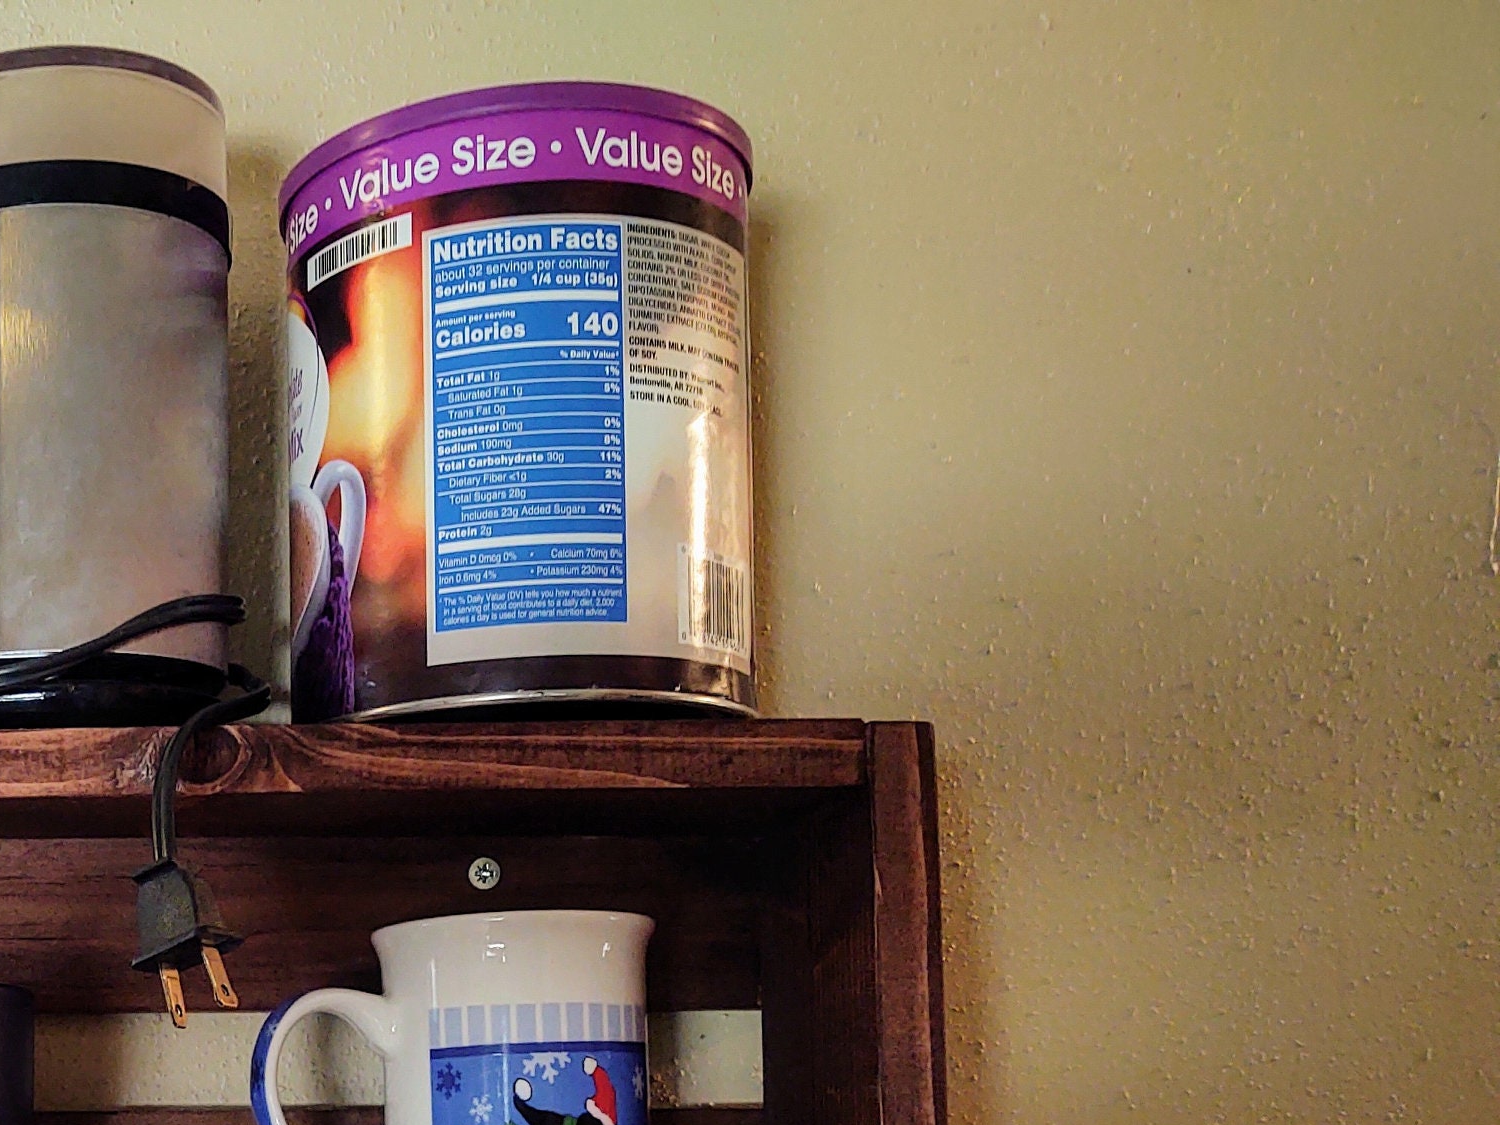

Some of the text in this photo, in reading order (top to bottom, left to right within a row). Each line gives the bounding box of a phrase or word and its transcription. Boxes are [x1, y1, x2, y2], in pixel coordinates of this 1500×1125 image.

[339, 153, 440, 210] Value
[452, 134, 536, 175] Size
[575, 127, 683, 177] Value
[692, 146, 734, 200] Size
[434, 227, 618, 263] Nutrition Facts
[435, 258, 610, 284] about 32 servings per container
[435, 281, 485, 298] Serving
[490, 276, 518, 289] size
[531, 273, 551, 286] 1/4
[556, 274, 580, 287] cup
[436, 315, 466, 327] Amount
[484, 309, 516, 320] serving
[436, 312, 618, 348] Calories 140
[570, 349, 590, 359] Daily
[437, 375, 464, 388] Total
[467, 372, 484, 382] Fat
[605, 366, 619, 376] 1%
[449, 389, 491, 403] Saturated
[494, 386, 508, 396] Fat
[512, 385, 523, 396] 1g
[449, 409, 474, 419] Trans
[494, 404, 506, 415] 0g
[437, 421, 500, 439] Cholesterol
[502, 421, 523, 432] 0mg
[437, 441, 478, 456] Sodium
[438, 459, 465, 472] Total
[468, 453, 543, 469] Carbohydrate
[600, 452, 621, 461] 11%
[450, 475, 481, 487] Dietary
[484, 471, 507, 482] Fiber
[450, 493, 471, 504] Total
[474, 489, 507, 499] Sugars
[461, 508, 498, 522] Includes
[521, 503, 551, 515] Added
[554, 502, 586, 514] Sugars
[599, 503, 621, 513] 47%
[438, 526, 492, 540] Protein 2g
[551, 548, 583, 558] Calcium
[439, 557, 468, 568] Vitamin
[537, 565, 579, 576] Potassium
[439, 575, 454, 585] Iron
